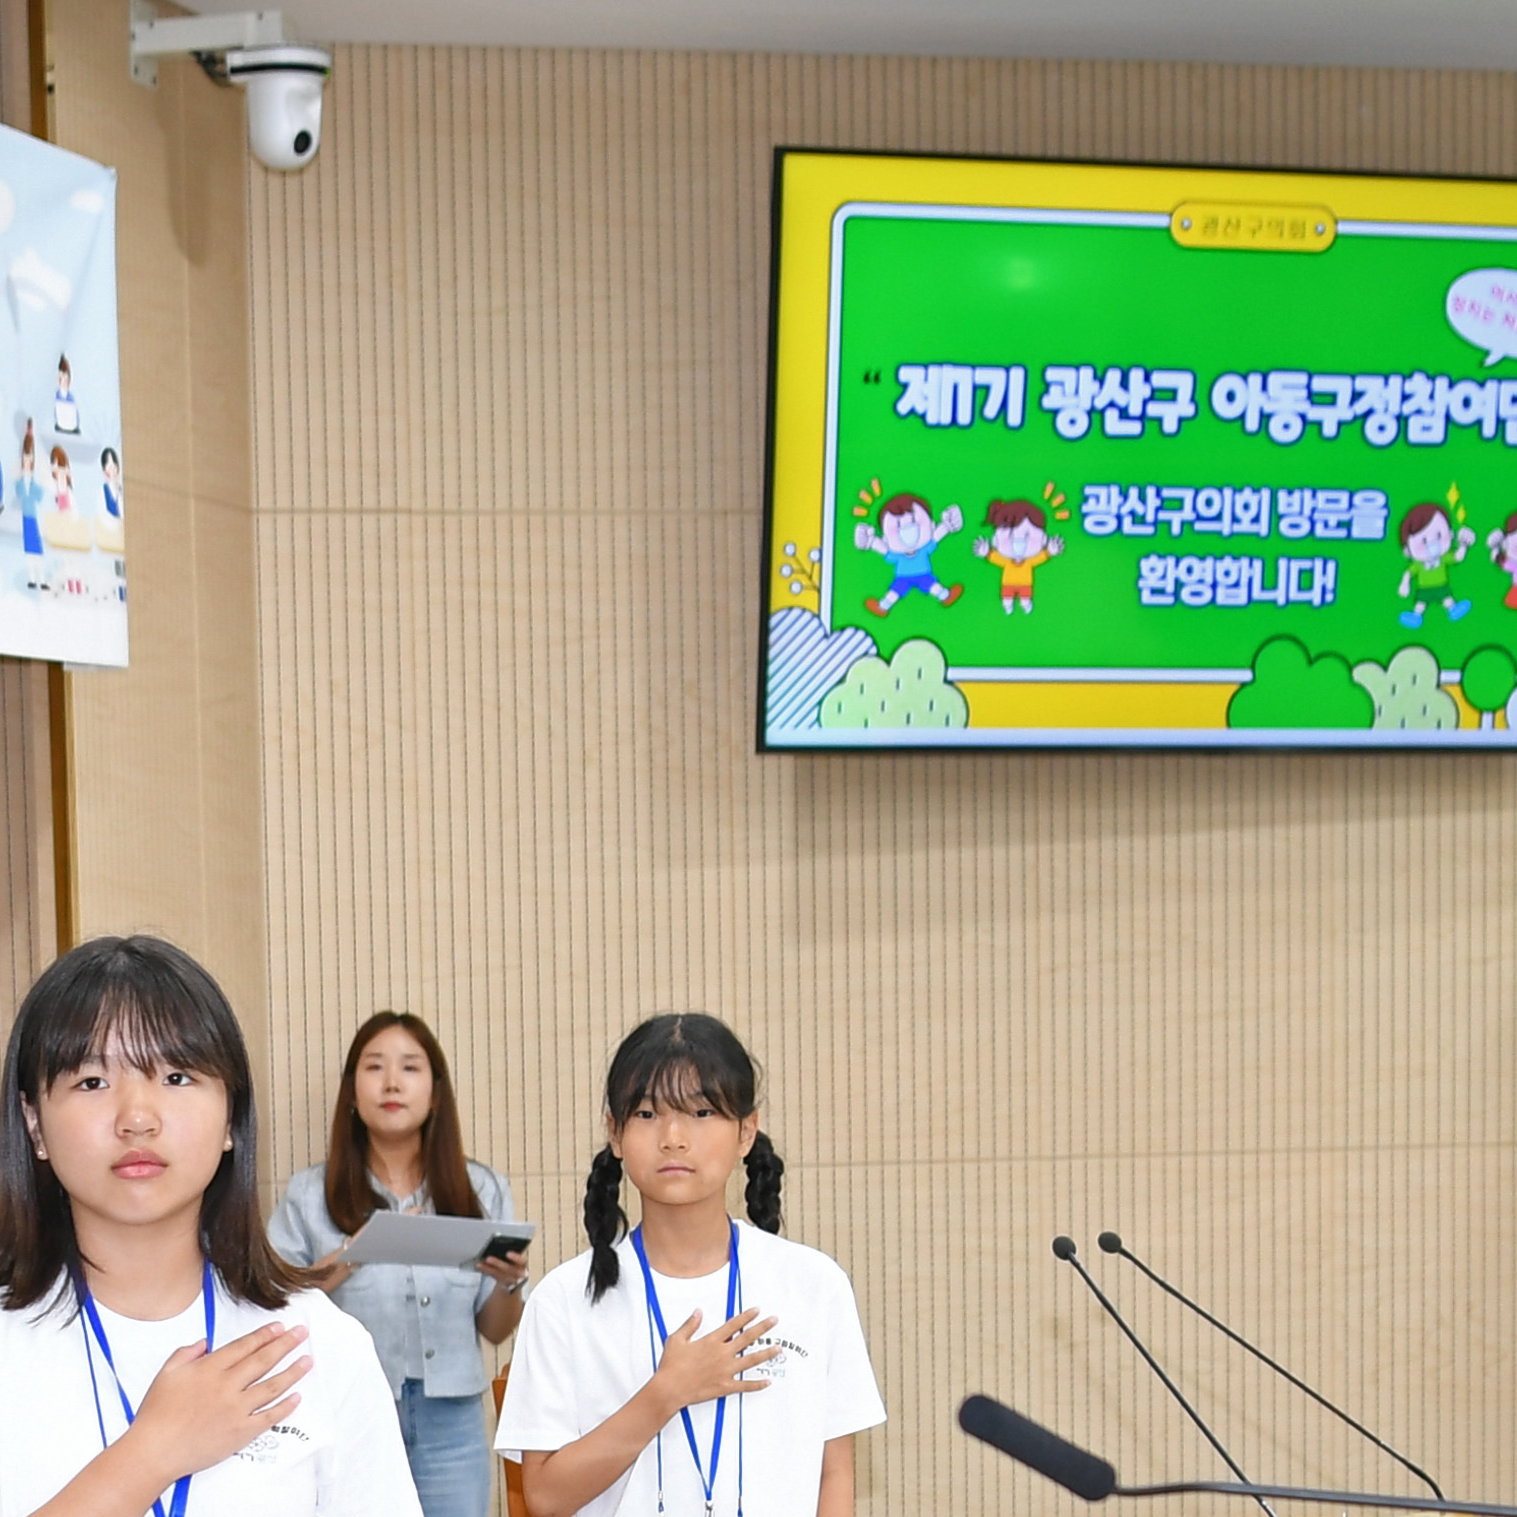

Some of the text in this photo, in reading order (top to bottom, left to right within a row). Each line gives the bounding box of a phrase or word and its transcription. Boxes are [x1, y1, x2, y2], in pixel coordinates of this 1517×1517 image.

[1040, 364, 1198, 441] 광산구
[1080, 483, 1389, 541] 광산구의회 방문을
[1137, 552, 1338, 608] 환영합니다!
